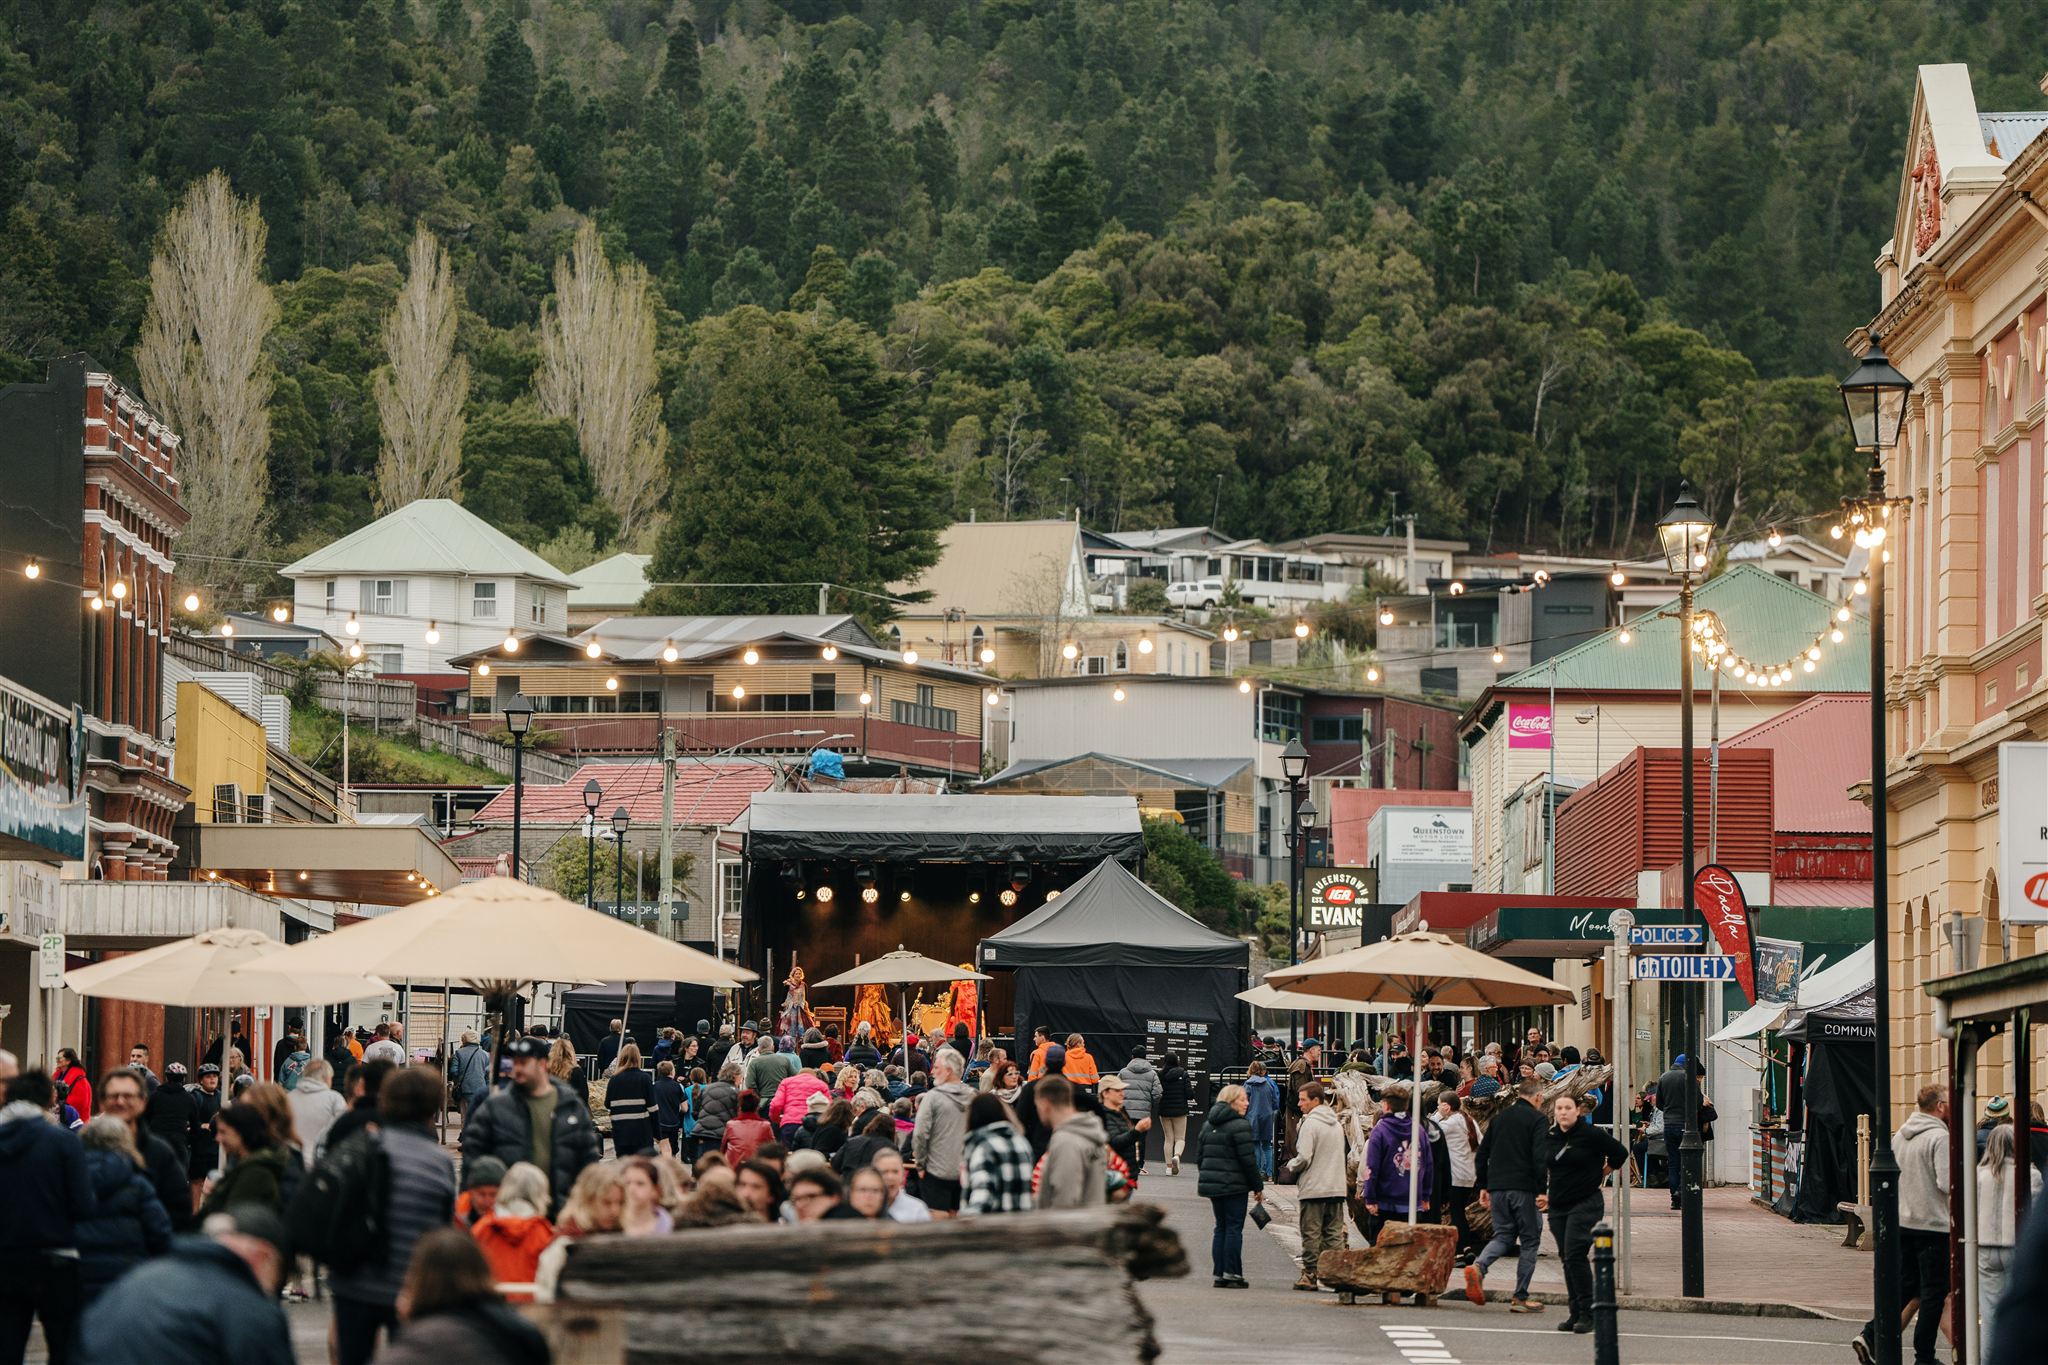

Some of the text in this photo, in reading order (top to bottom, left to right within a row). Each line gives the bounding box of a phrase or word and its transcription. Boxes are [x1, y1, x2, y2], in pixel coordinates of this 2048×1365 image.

[1413, 827, 1465, 835] QUEENSTOWN
[1311, 873, 1369, 896] QUEENSTOWN
[1701, 874, 1745, 939] Paella
[1311, 906, 1363, 926] EVANS
[43, 936, 62, 949] 2P
[1631, 928, 1685, 943] POLICE
[1661, 956, 1720, 978] TOILET
[1824, 1024, 1876, 1037] COMMUN
